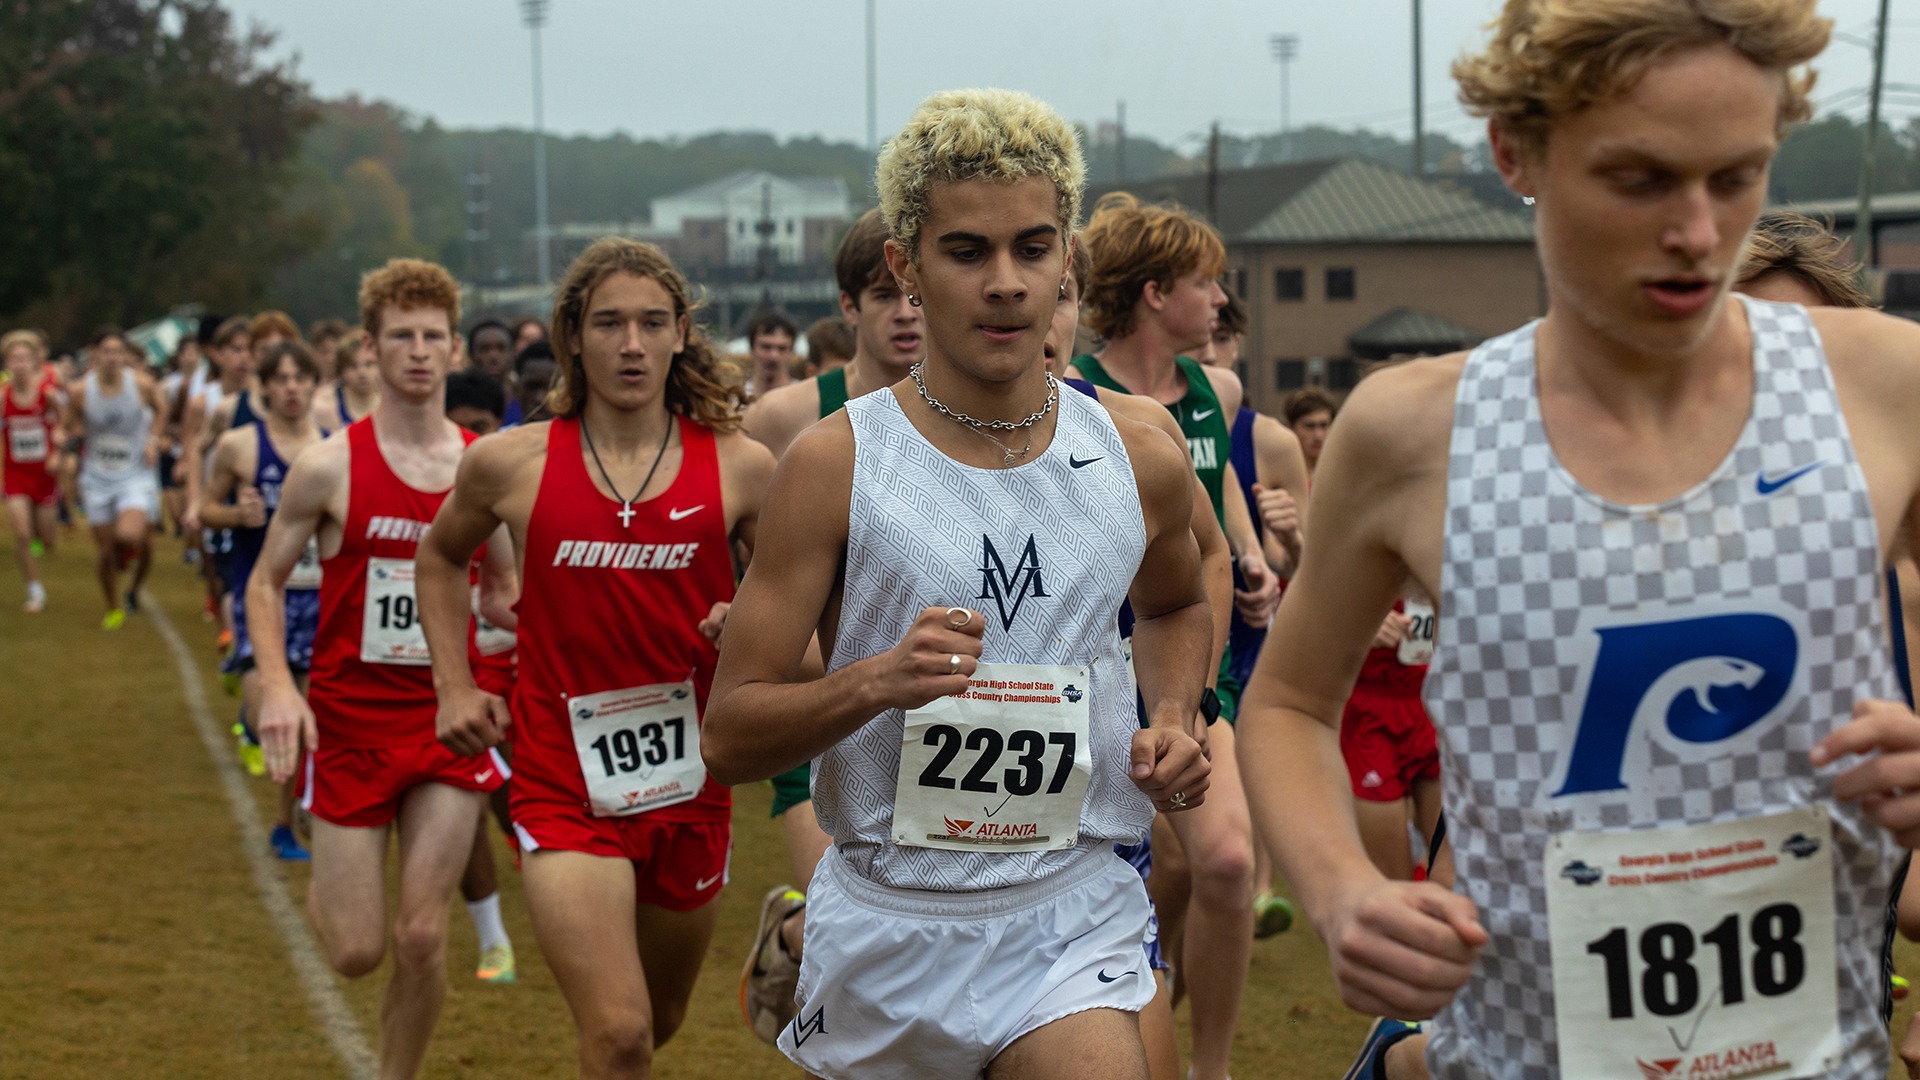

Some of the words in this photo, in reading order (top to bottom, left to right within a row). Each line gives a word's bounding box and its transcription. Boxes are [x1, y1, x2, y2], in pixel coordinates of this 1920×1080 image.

[552, 540, 699, 570] PROVIDENCE
[377, 594, 420, 630] 19
[1410, 614, 1434, 640] 20
[967, 679, 989, 688] orgia
[989, 680, 1007, 690] High
[1008, 681, 1034, 690] School
[1034, 681, 1054, 691] State
[972, 691, 1003, 702] Country
[1003, 693, 1061, 704] Championships
[590, 716, 685, 777] 1937
[918, 724, 1076, 796] 2237
[976, 823, 1037, 836] ATLANTA
[1587, 902, 1806, 1020] 1818
[1688, 1040, 1777, 1073] ATLANTA
